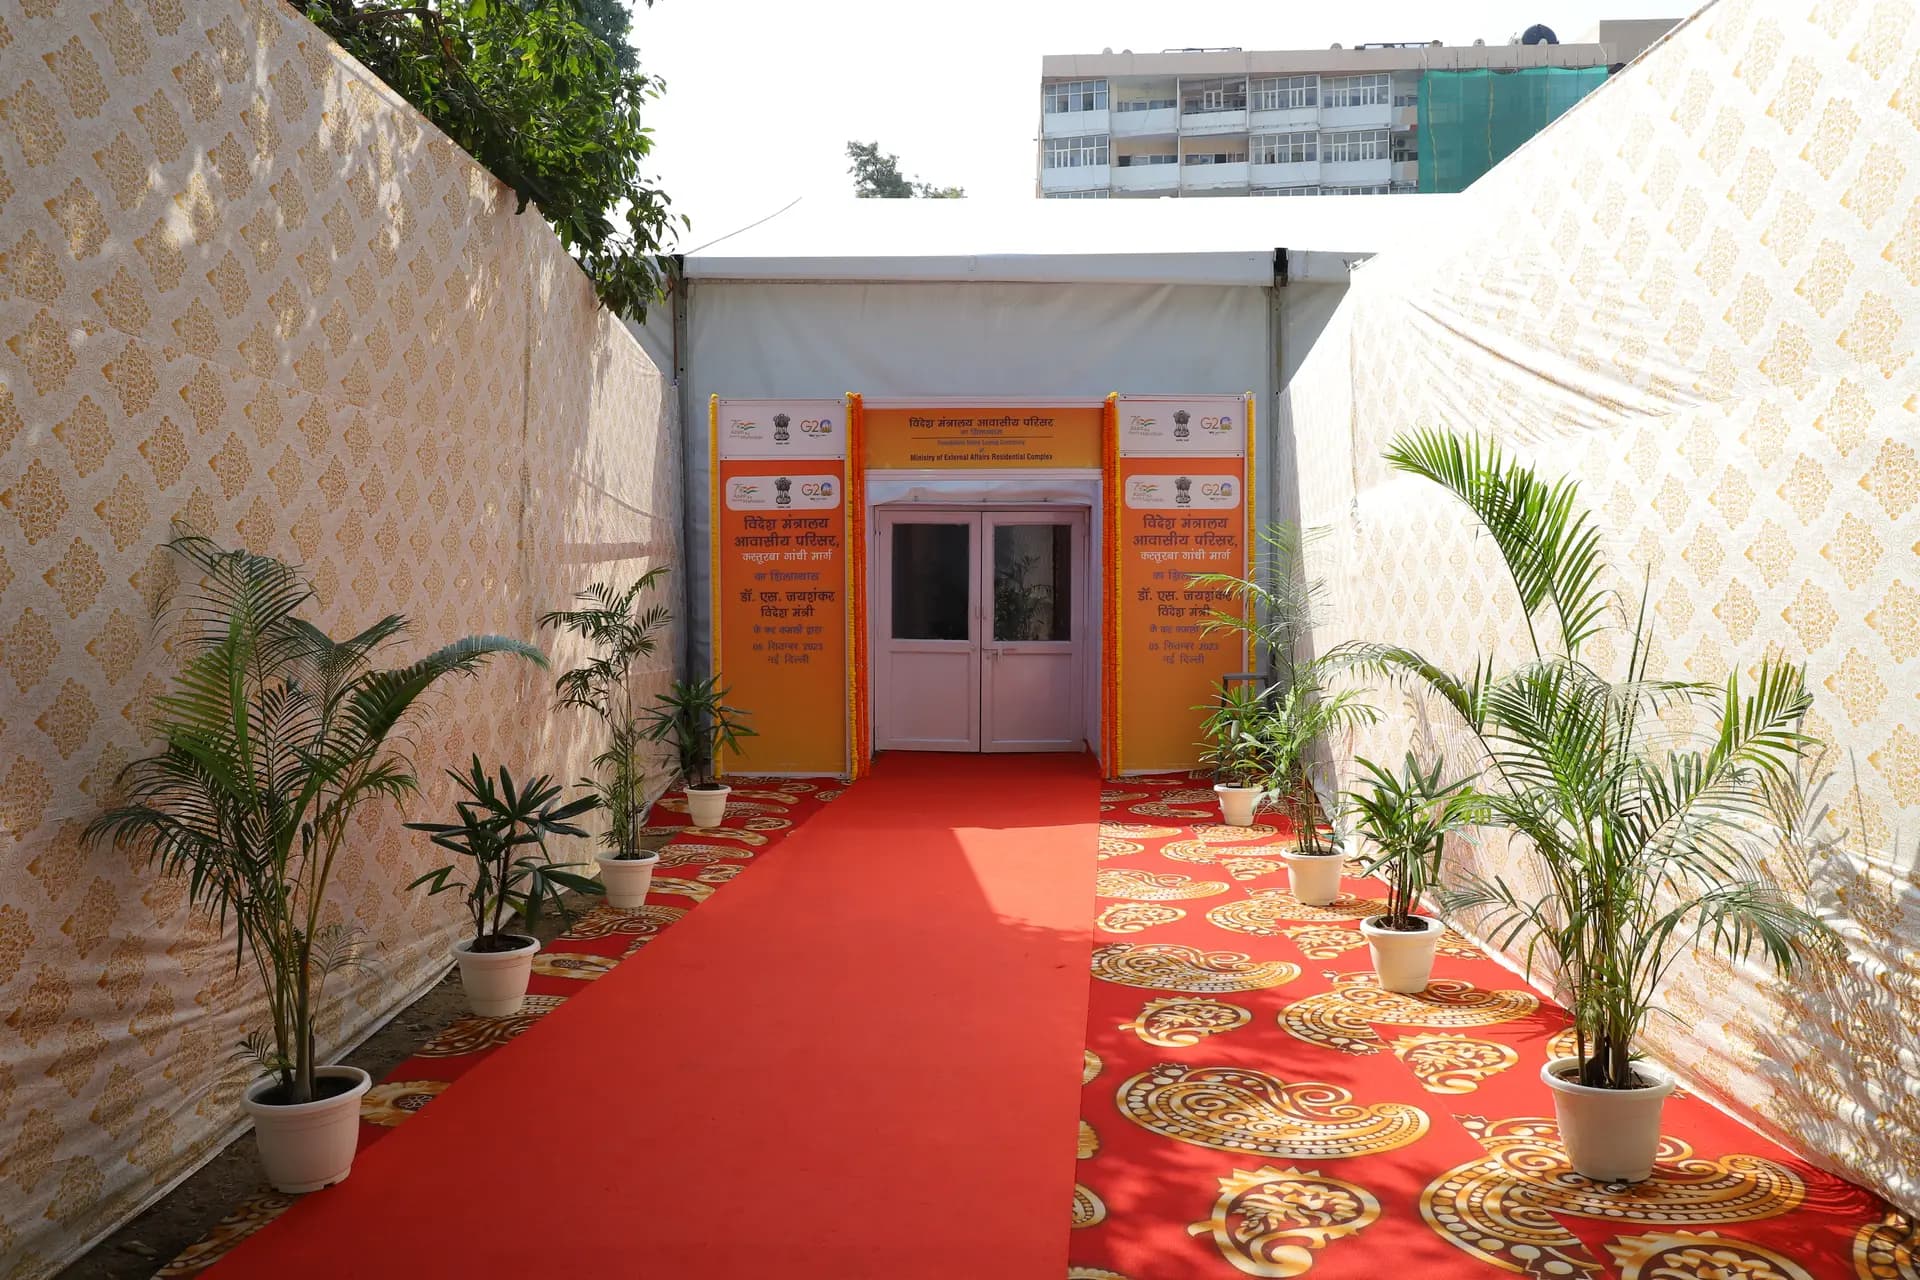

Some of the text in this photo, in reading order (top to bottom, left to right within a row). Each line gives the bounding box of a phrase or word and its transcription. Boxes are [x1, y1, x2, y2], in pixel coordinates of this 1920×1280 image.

[801, 419, 832, 433] G20
[910, 416, 1054, 429] विदेश मंत्रालय आवासीय परिसर
[1200, 416, 1233, 430] G20
[911, 455, 935, 463] Ministry
[802, 482, 833, 496] G20
[1202, 483, 1233, 497] G20
[744, 514, 830, 530] विदेश मंत्रालय
[1143, 514, 1229, 530] विदेश मंत्रालय
[735, 532, 840, 548] आवासीय परिसर,
[1133, 531, 1238, 548] आवासीय परिसर,
[742, 549, 833, 565] कस्तूरबा गांधी मार्ग
[1141, 548, 1232, 564] कस्तूरबा गांधी मार्ग
[760, 592, 782, 603] एस.
[786, 587, 836, 603] जयशंकर
[1137, 588, 1153, 601] डॉ.
[1157, 591, 1179, 601] एस.
[761, 606, 815, 619] विदेश मंत्री
[1158, 605, 1211, 618] विदेश मंत्री
